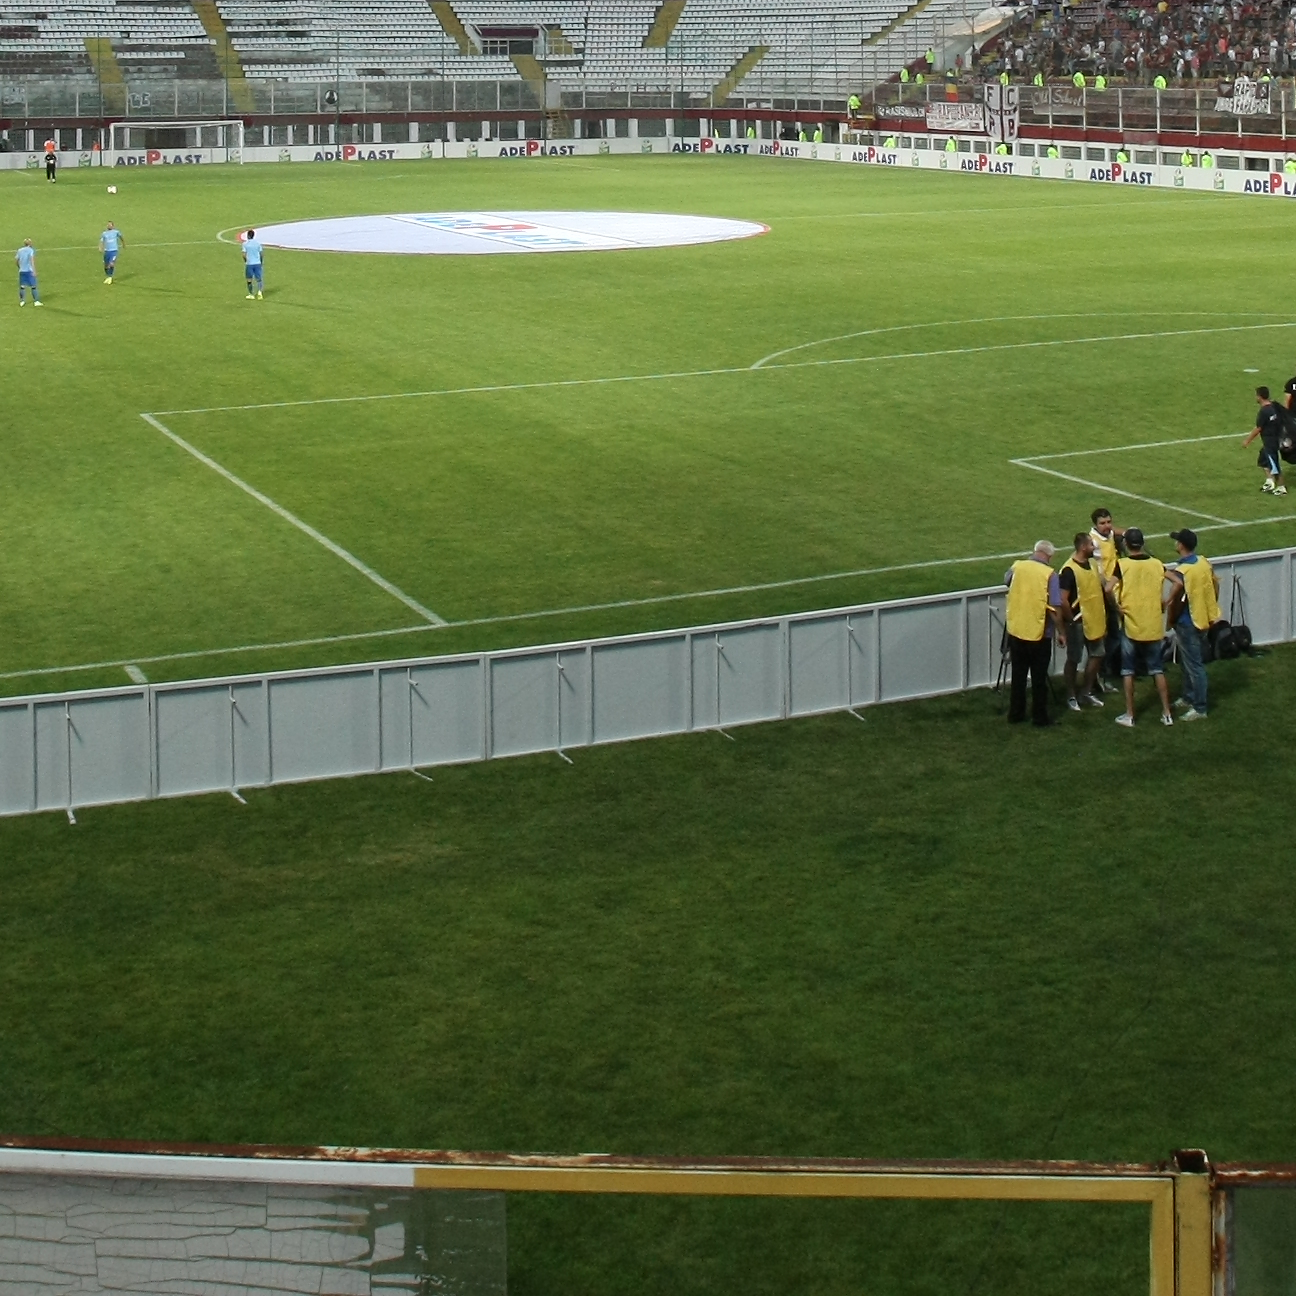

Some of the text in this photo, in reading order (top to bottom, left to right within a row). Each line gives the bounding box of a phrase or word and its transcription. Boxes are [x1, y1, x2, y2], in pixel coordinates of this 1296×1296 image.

[314, 146, 395, 162] ADEPLAST
[672, 138, 749, 154] ADEPLAST
[759, 141, 799, 157] ADEPLAST
[116, 150, 202, 165] ADEPLAST
[852, 147, 897, 164] ADEPLAST
[961, 154, 1013, 174] ADEPLAST
[1090, 163, 1152, 184] ADEPLAST
